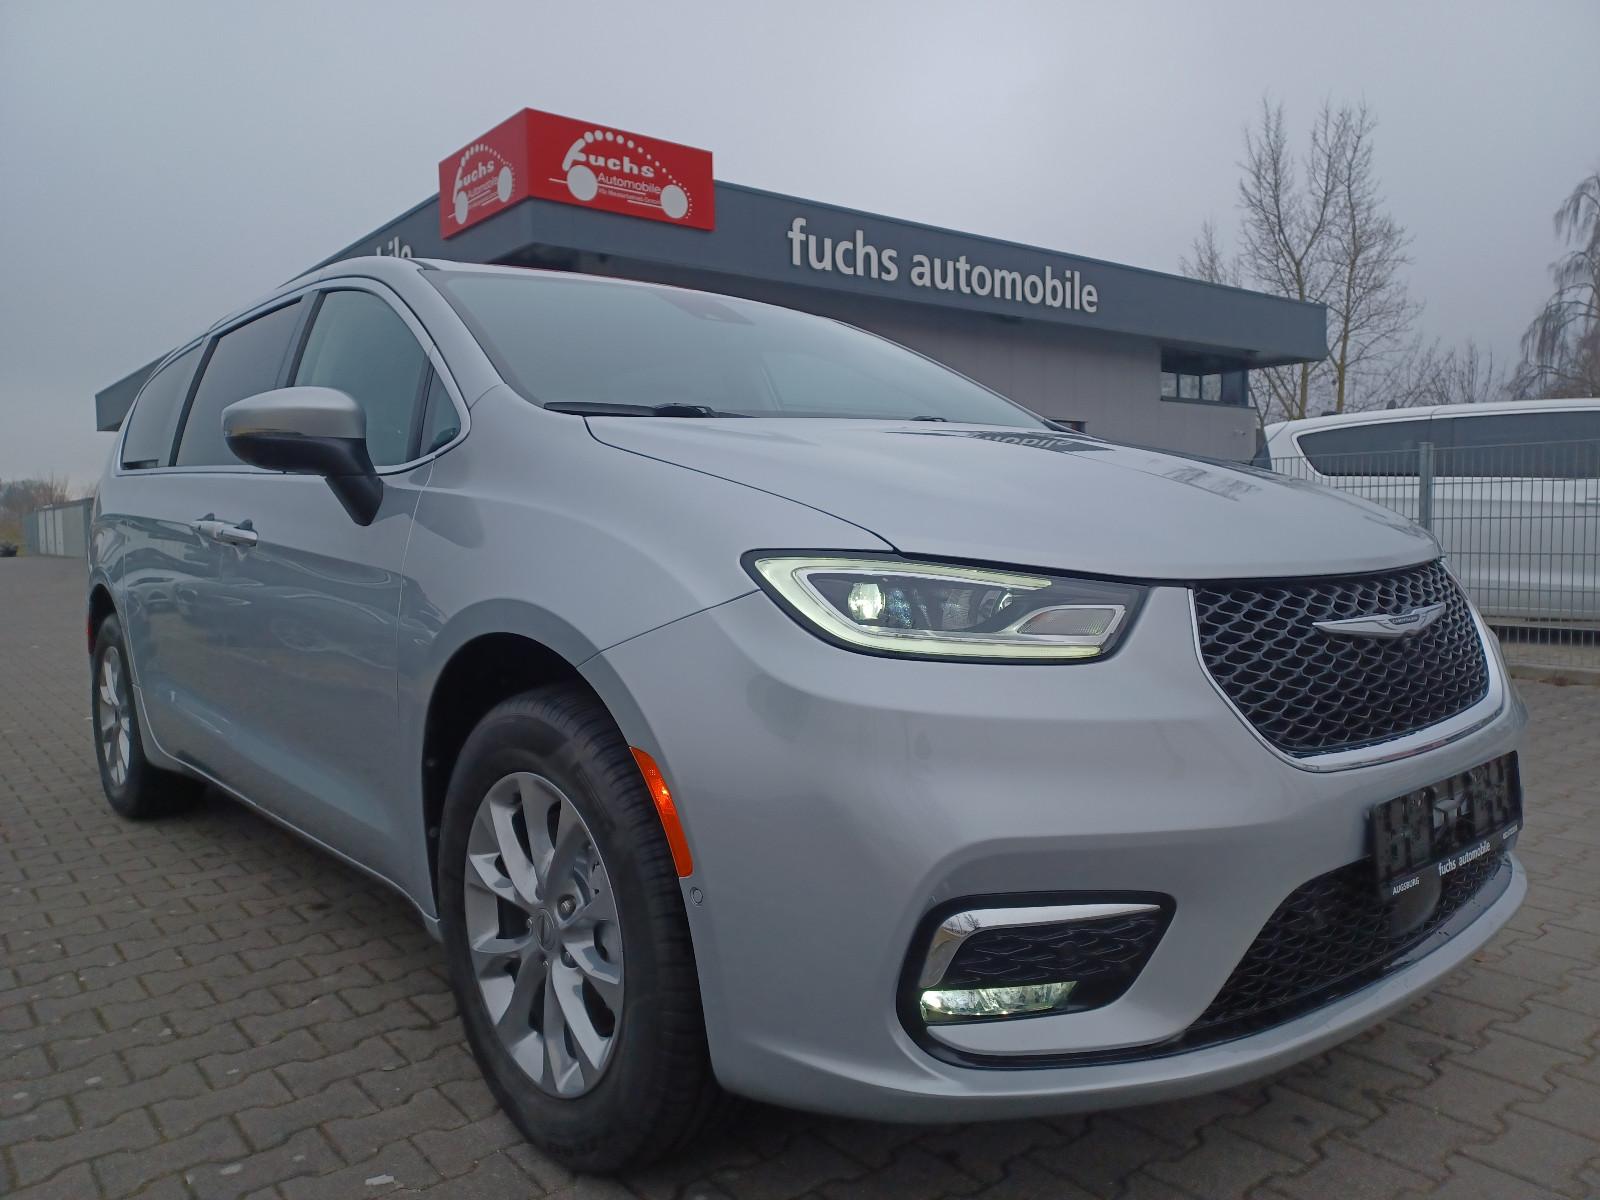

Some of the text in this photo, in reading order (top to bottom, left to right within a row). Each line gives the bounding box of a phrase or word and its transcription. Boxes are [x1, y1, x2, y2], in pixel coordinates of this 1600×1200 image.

[598, 172, 662, 194] Automobile
[787, 217, 1098, 313] fuchs automobile
[1439, 840, 1491, 876] fuchs automobile
[1392, 876, 1420, 896] AUGSBURG
